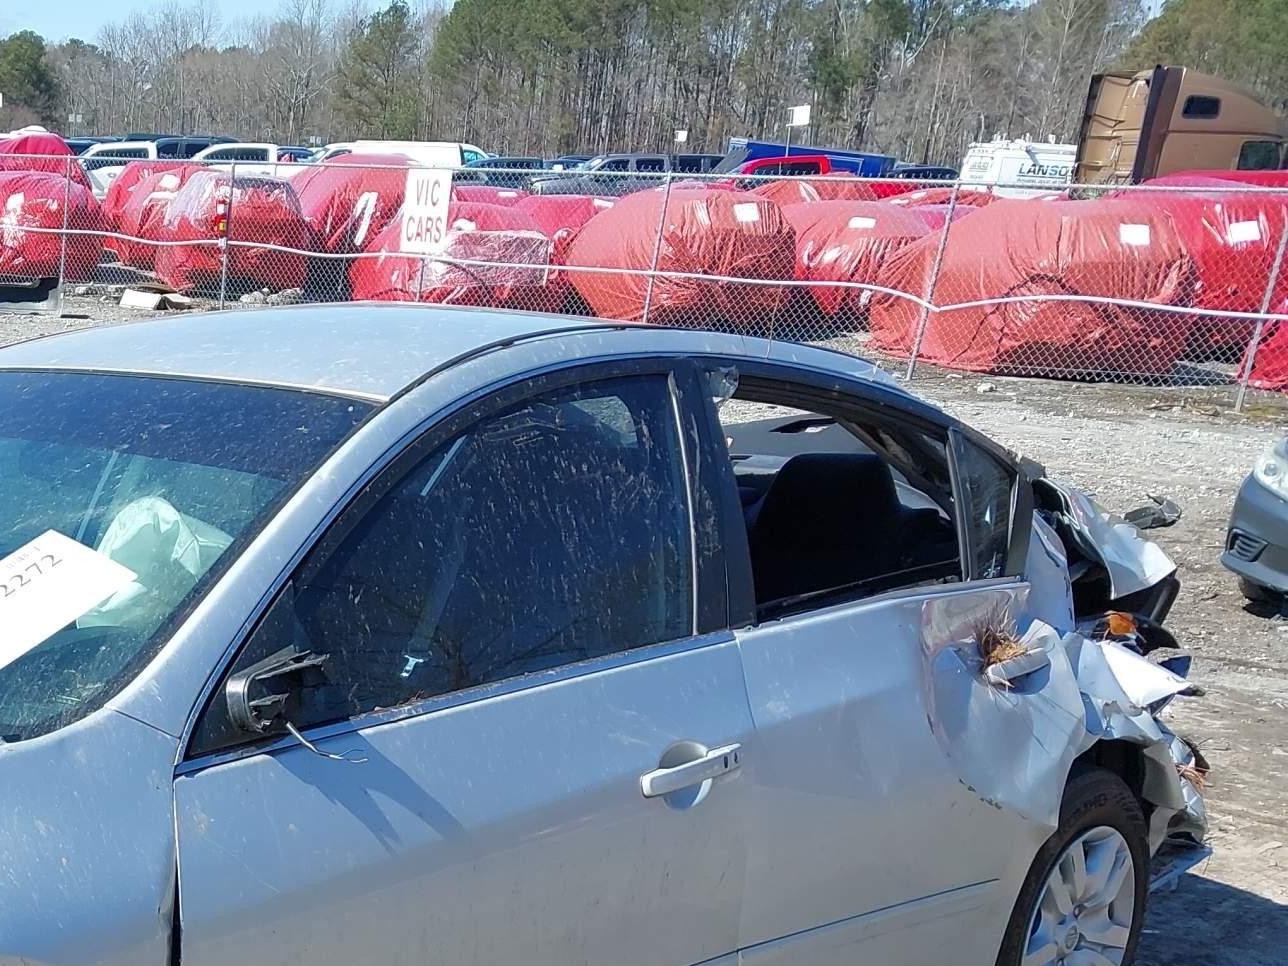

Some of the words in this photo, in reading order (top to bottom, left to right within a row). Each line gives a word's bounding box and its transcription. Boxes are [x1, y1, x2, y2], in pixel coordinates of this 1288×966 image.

[1018, 163, 1073, 177] LANSO
[417, 179, 441, 207] VIC
[406, 215, 443, 244] CARS
